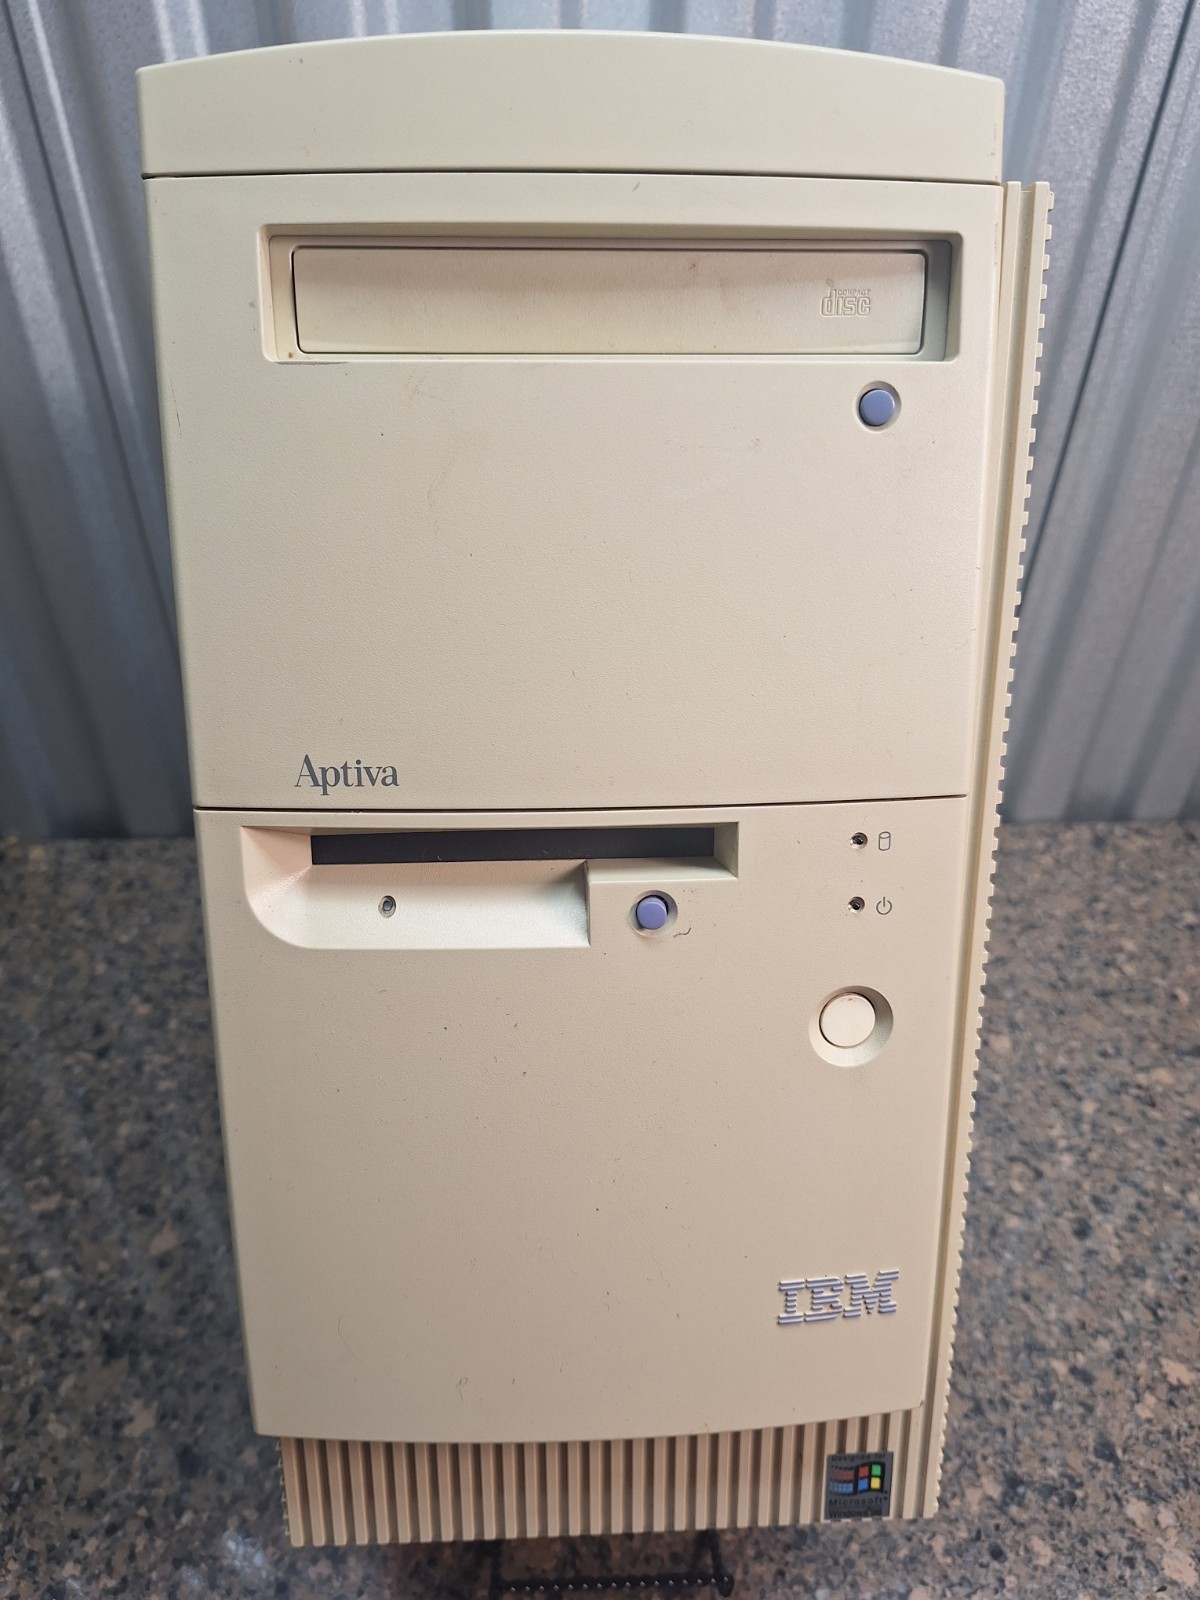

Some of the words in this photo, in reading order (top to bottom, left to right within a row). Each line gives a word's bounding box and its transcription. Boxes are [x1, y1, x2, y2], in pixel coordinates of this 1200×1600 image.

[821, 288, 871, 317] disc
[294, 754, 399, 796] Aptiva
[778, 1268, 899, 1325] IBM
